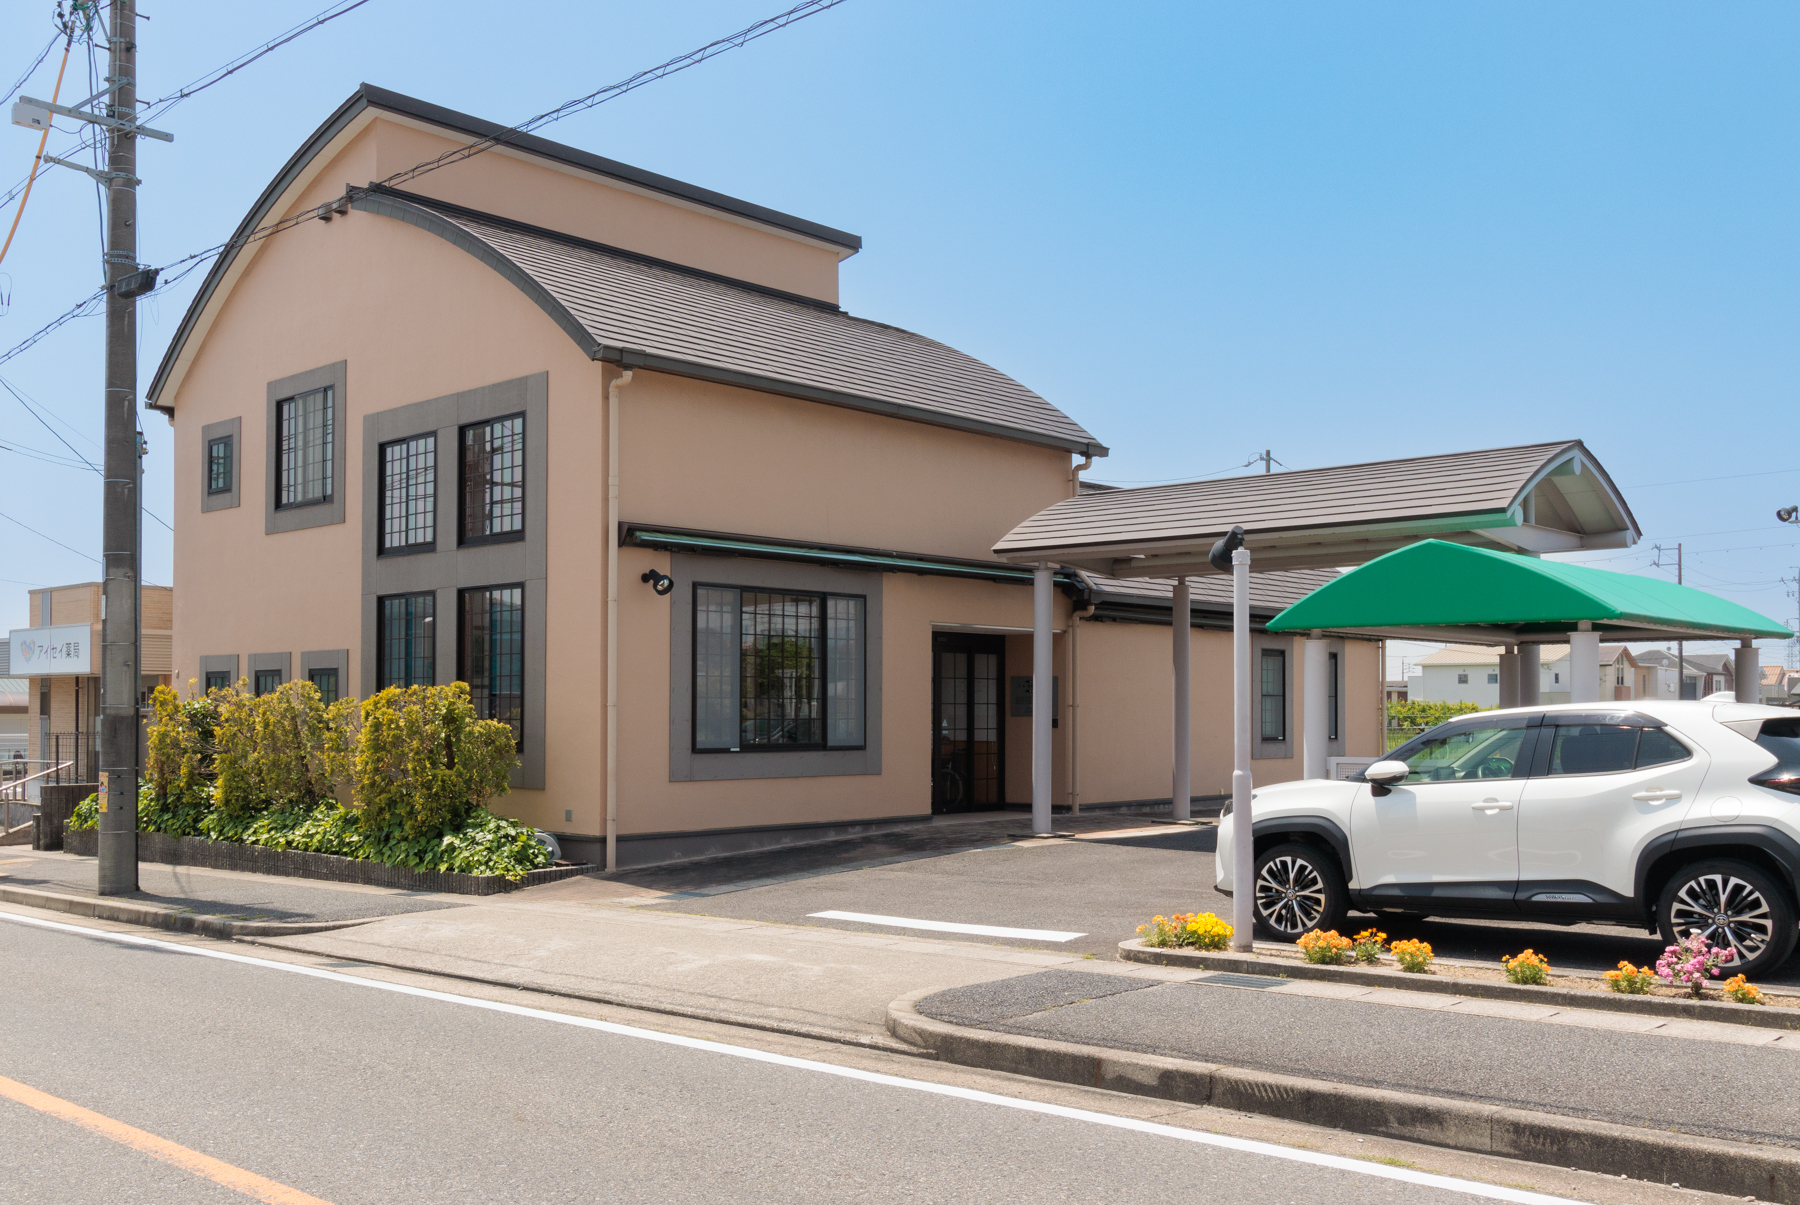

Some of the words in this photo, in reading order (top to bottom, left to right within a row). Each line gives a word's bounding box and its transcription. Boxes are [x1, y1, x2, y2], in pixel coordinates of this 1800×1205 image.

[37, 642, 80, 660] アイセイ薬局
